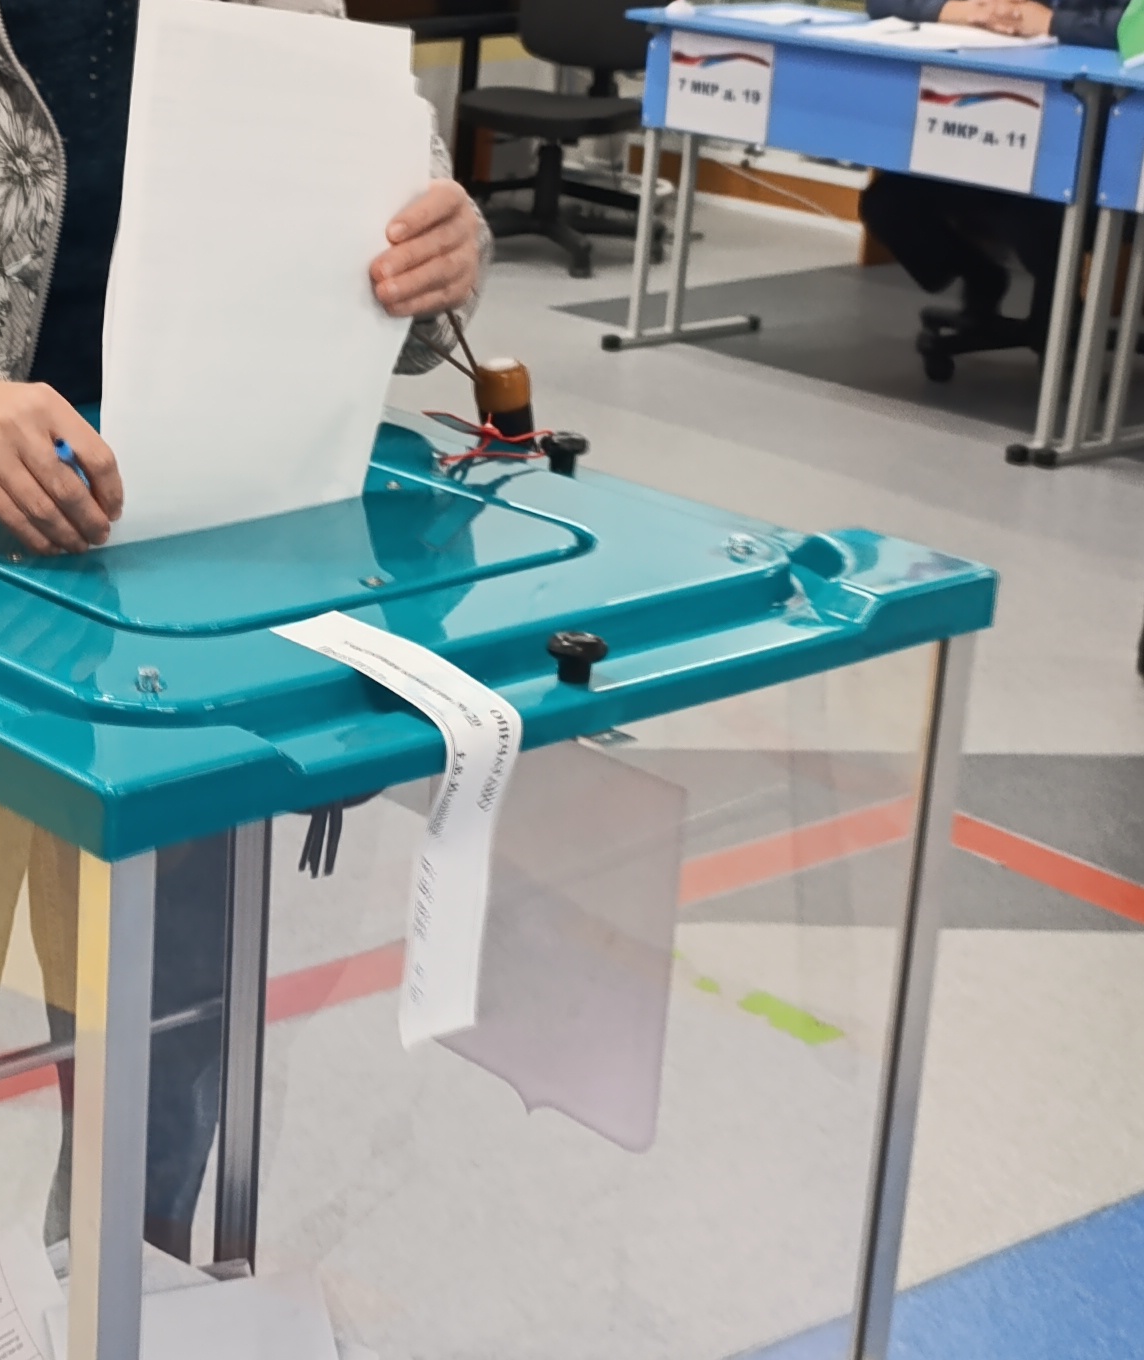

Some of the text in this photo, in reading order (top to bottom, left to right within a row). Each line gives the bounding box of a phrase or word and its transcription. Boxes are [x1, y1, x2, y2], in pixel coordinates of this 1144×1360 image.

[679, 78, 687, 91] 7
[690, 80, 719, 97] МКР
[927, 117, 1026, 150] 7 МКР д. 11
